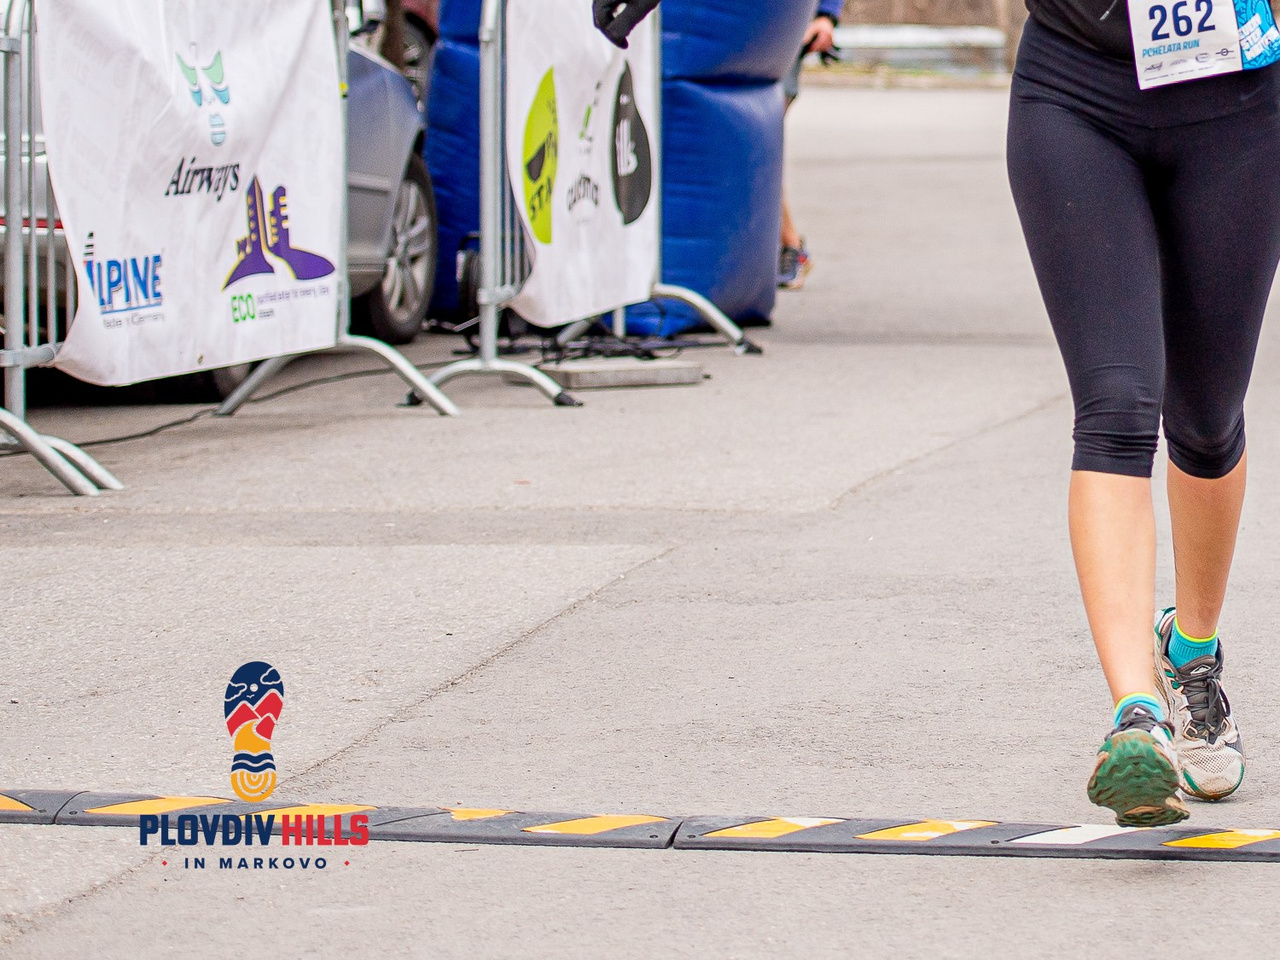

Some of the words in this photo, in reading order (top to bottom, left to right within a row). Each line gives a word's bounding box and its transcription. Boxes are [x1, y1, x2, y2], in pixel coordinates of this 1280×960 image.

[1142, 42, 1182, 58] PCHELATA
[1182, 39, 1200, 50] RUN
[164, 155, 240, 202] Airways
[231, 292, 256, 323] ECO
